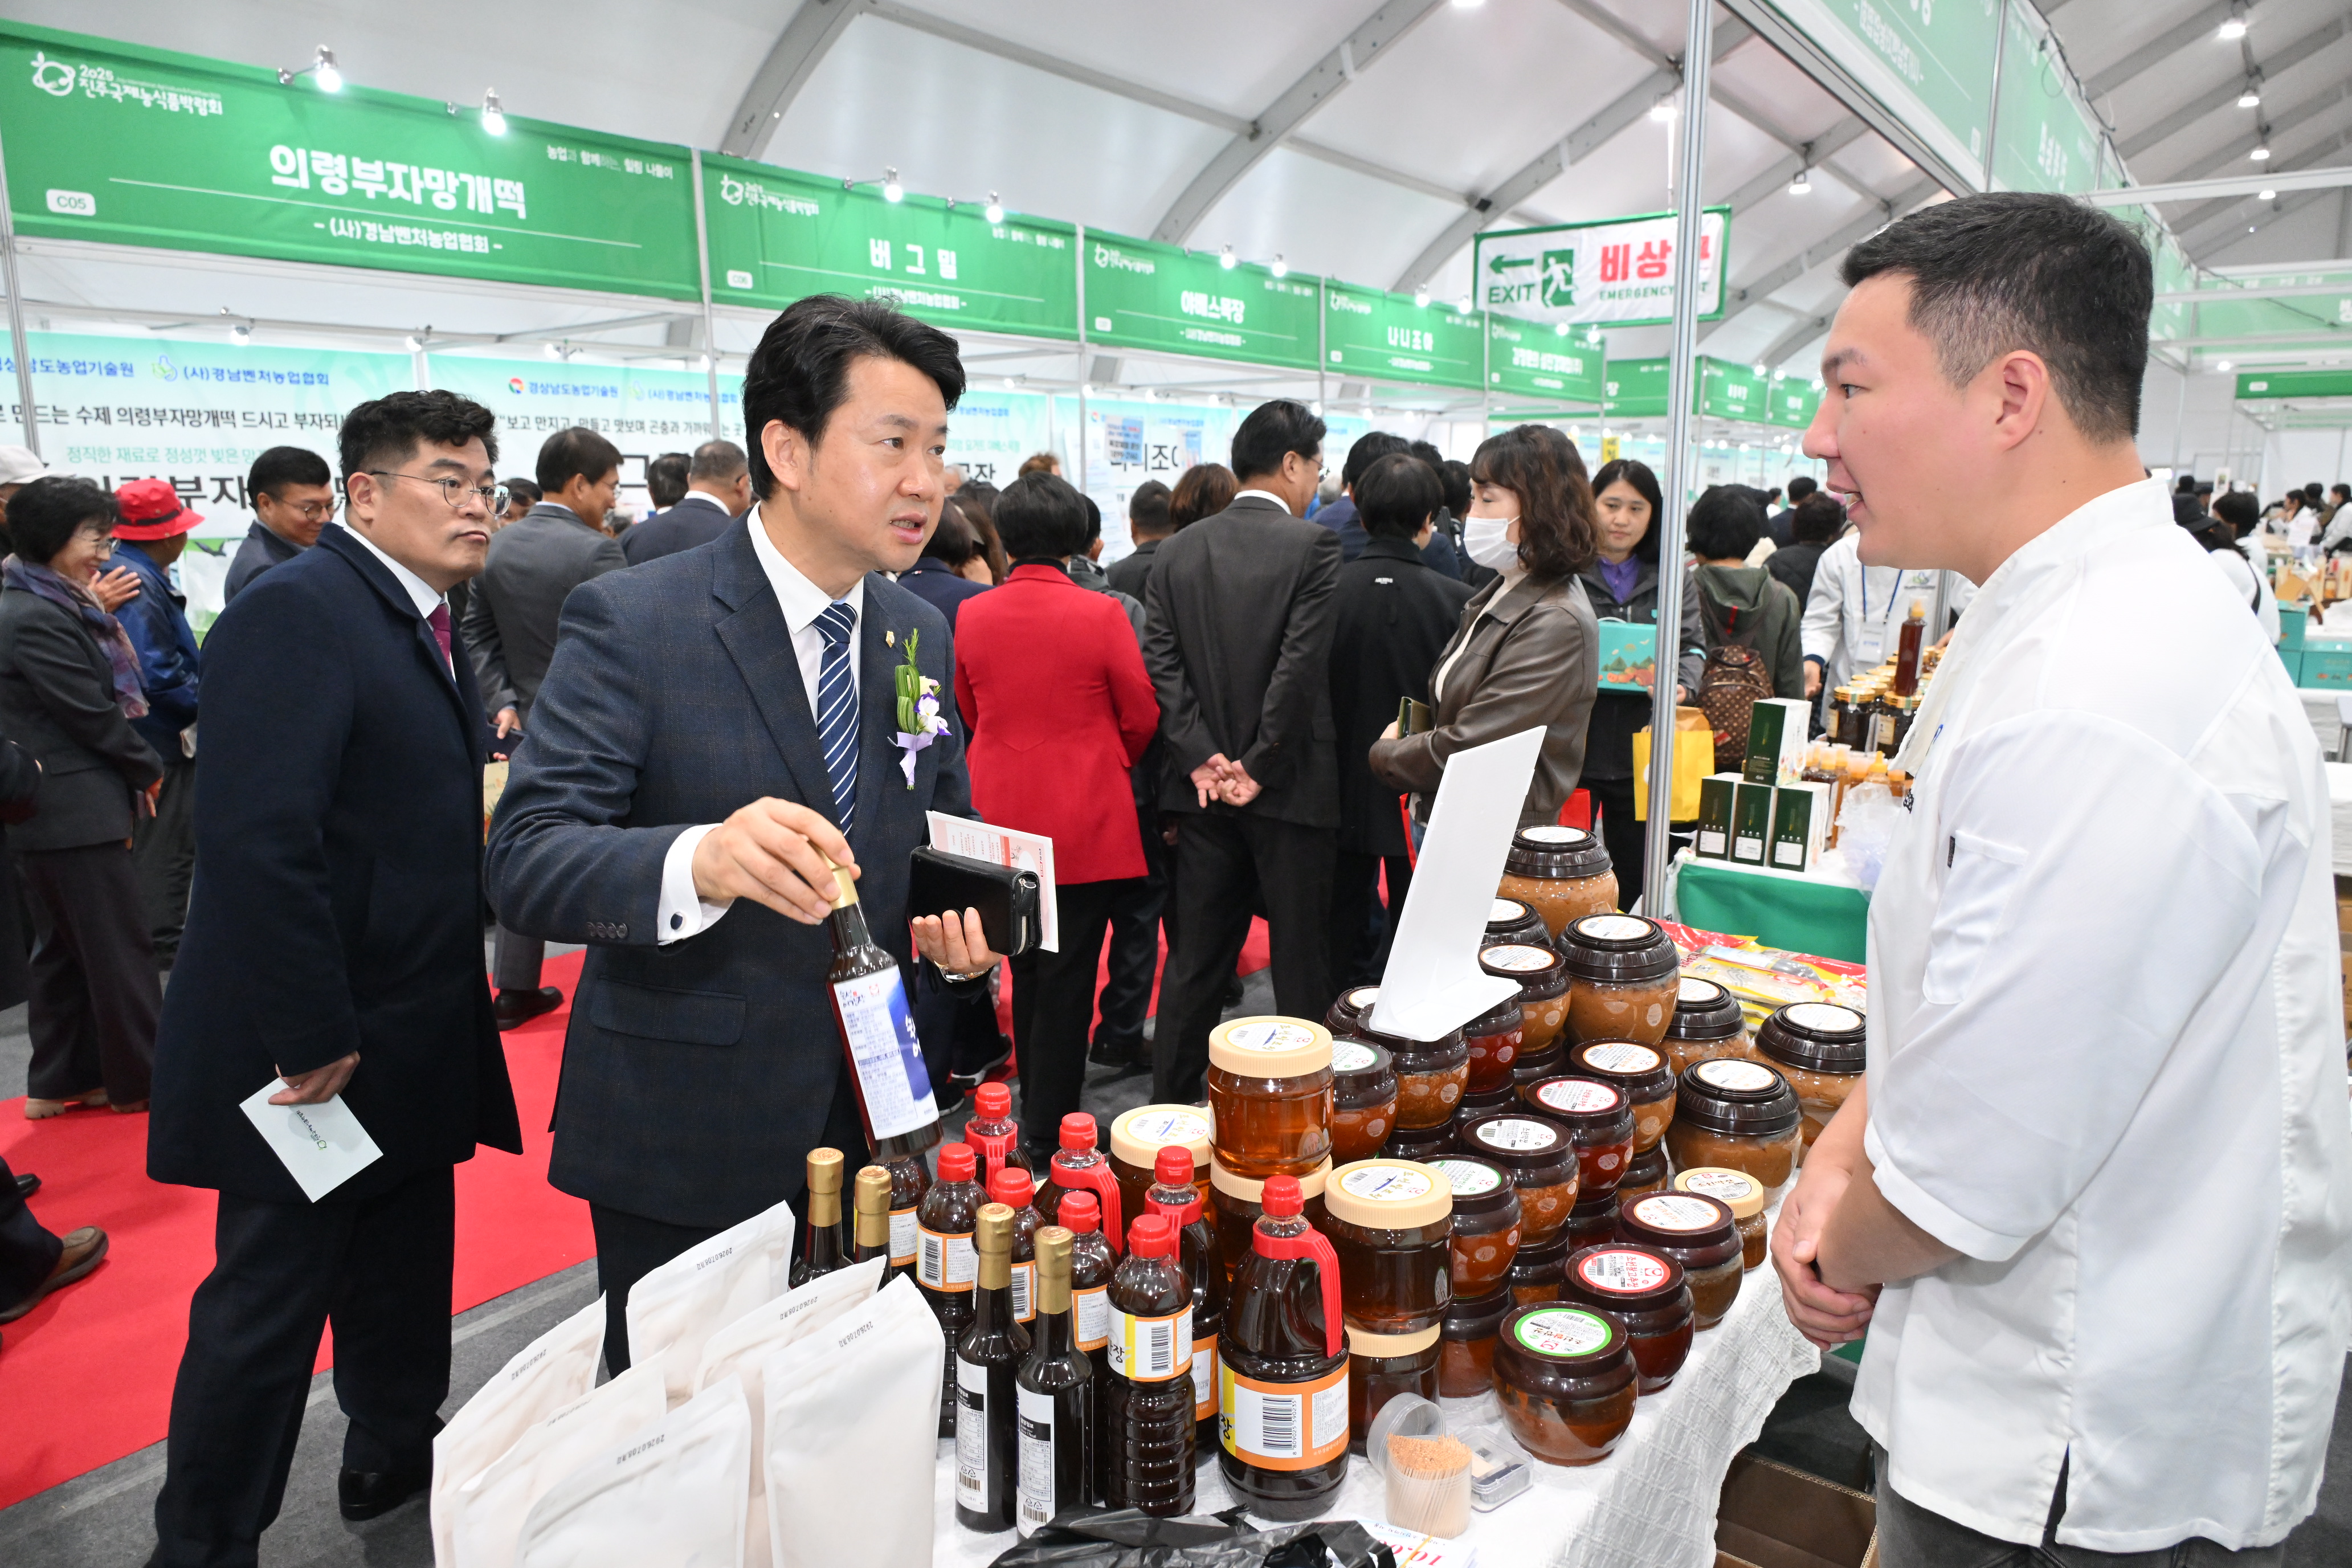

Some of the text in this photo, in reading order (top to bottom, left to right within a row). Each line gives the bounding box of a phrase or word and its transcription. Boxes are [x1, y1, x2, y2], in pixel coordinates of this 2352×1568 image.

[79, 64, 113, 81] 2025
[79, 77, 222, 116] 진주국제농식품박람회
[270, 145, 525, 218] 의령부자망개떡
[56, 195, 86, 210] C05
[1489, 281, 1533, 304] EXIT
[1600, 287, 1674, 300] EMERGENCY
[183, 366, 329, 386] (사)경남벤처농업협회
[76, 407, 111, 426] 수제
[118, 407, 236, 428] 의령부자망개떡
[242, 411, 287, 430] 드시고
[66, 446, 112, 464] 정직한
[116, 447, 160, 464] 재료로
[166, 447, 206, 464] 정성껏
[211, 448, 238, 464] 빚은
[1626, 1256, 1639, 1288] 조선찰고추장
[1020, 1418, 1034, 1428] 영양정보
